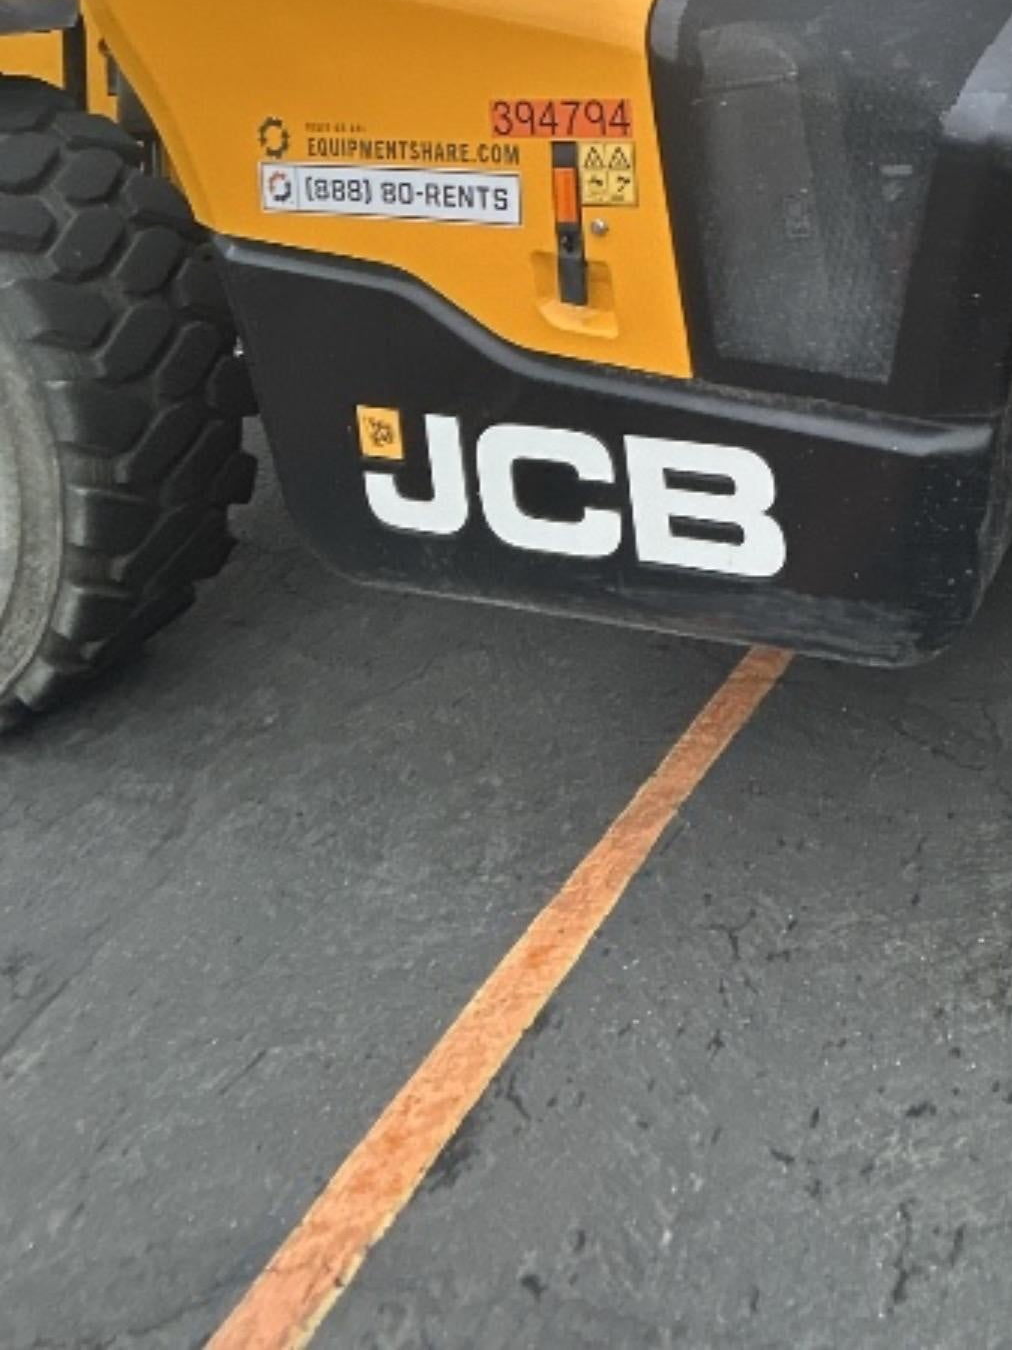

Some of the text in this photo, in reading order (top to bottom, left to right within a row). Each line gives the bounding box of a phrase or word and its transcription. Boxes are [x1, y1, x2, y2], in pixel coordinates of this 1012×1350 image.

[492, 99, 632, 137] 394794
[307, 137, 520, 166] EQUIPMENTSHARE.COM
[304, 176, 509, 211] (888) 80-RENTS
[363, 413, 787, 578] JCB
